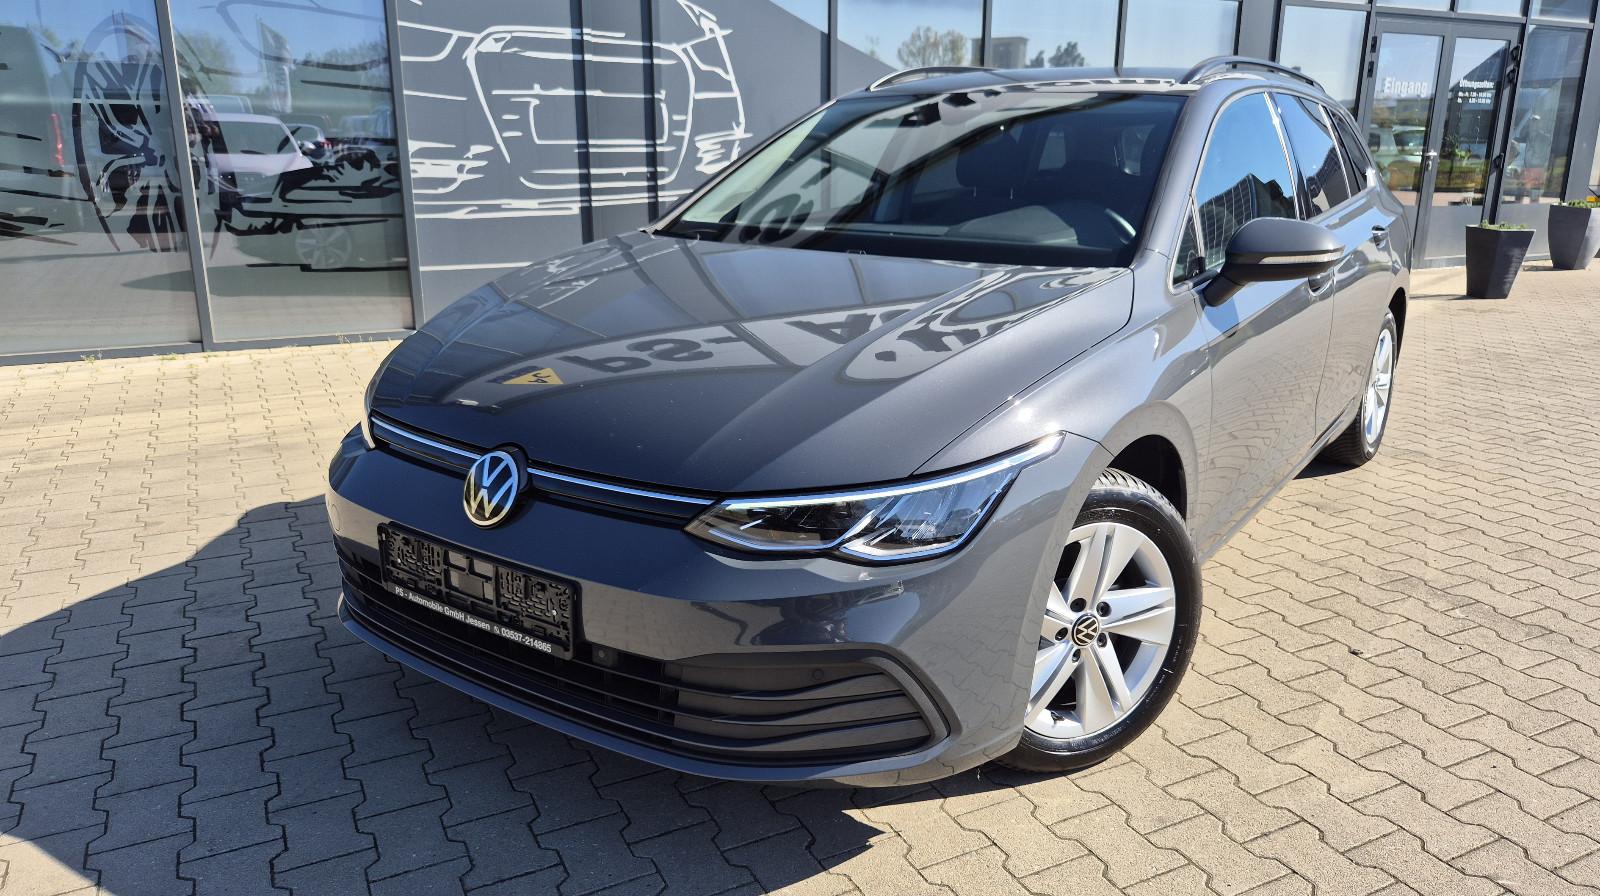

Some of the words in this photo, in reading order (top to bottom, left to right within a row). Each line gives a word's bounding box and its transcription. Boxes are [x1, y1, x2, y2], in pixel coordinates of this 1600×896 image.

[1383, 77, 1428, 98] Eingang
[395, 586, 404, 597] PS
[408, 592, 444, 613] Automobile
[444, 606, 465, 621] GmbH
[465, 614, 491, 631] Jessen
[501, 627, 552, 653] 03537-214865
